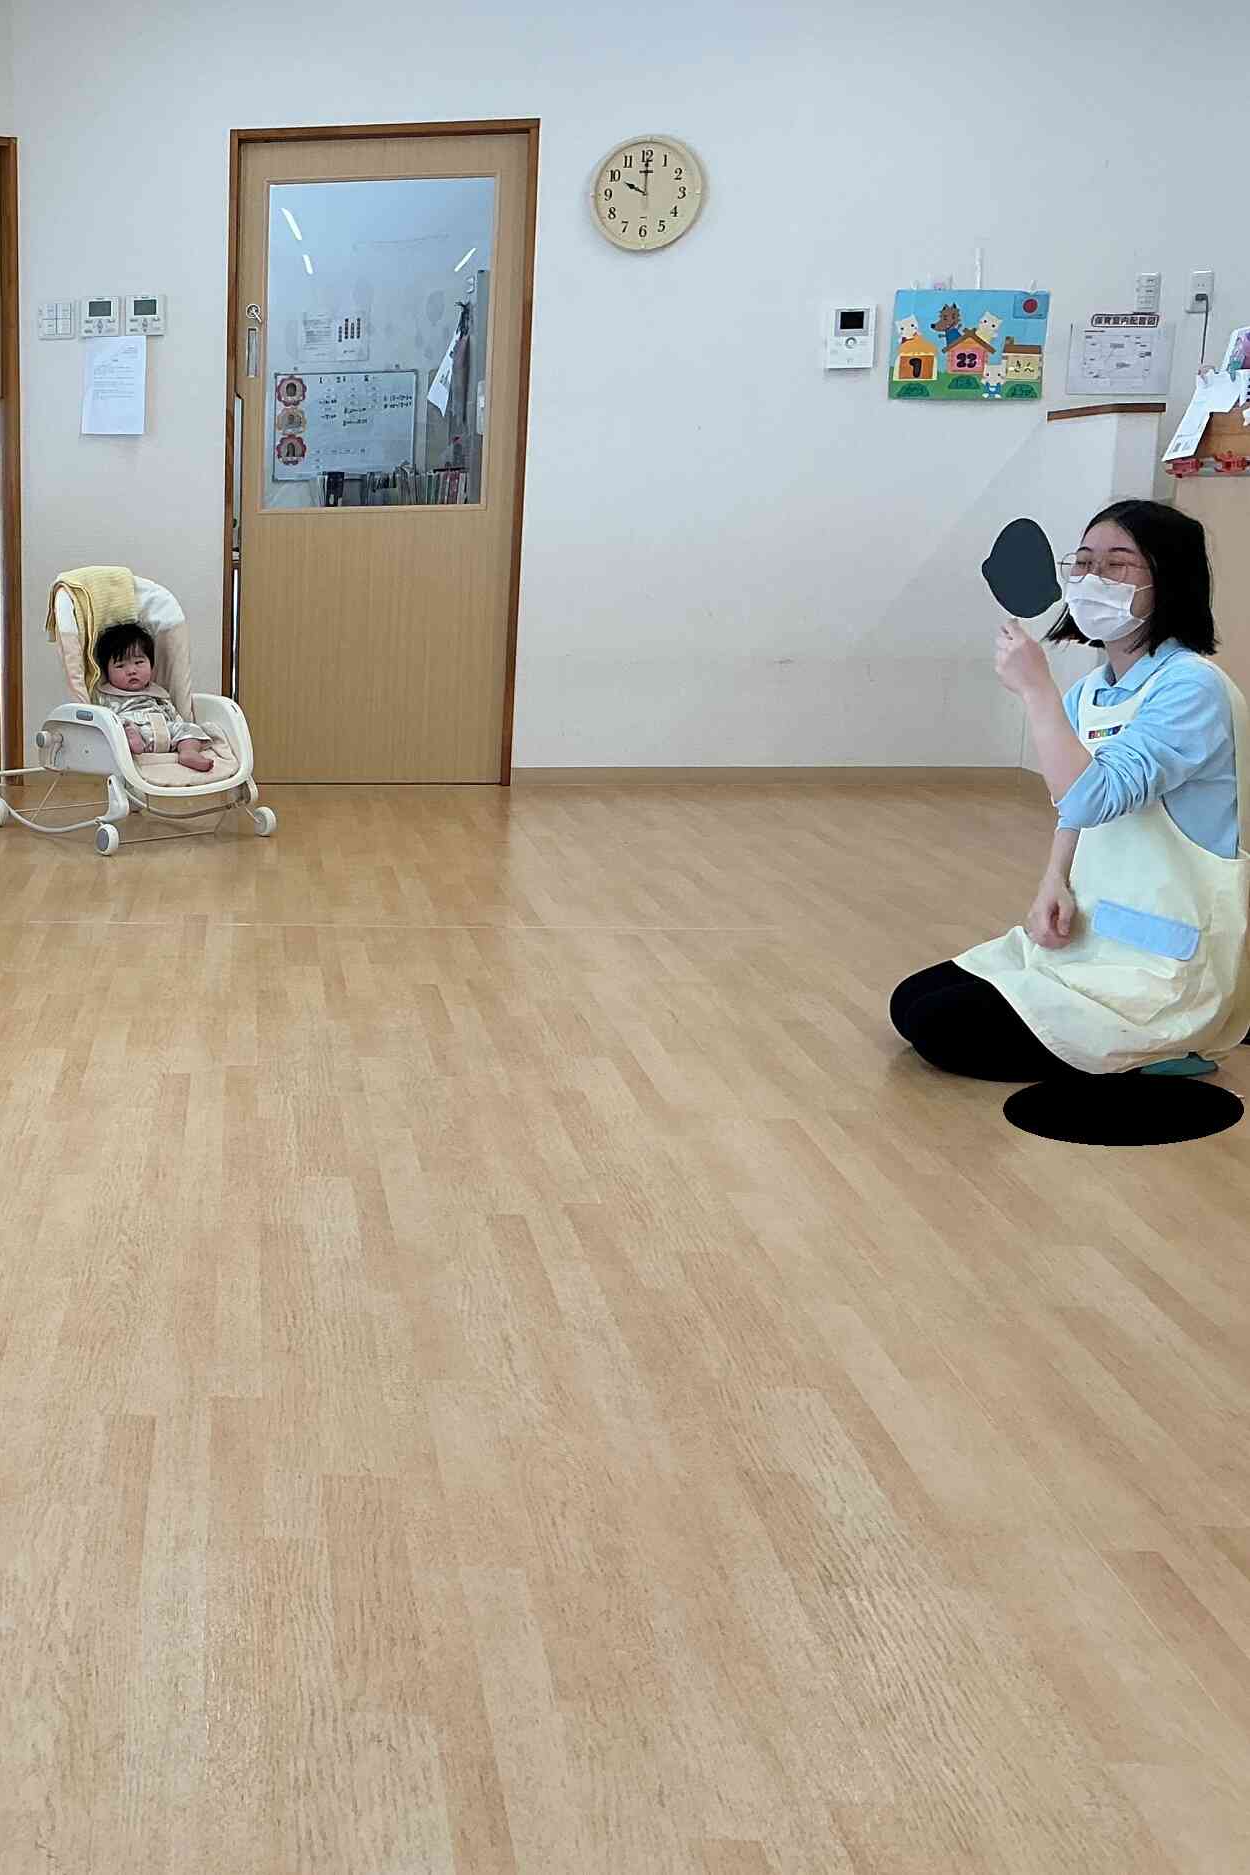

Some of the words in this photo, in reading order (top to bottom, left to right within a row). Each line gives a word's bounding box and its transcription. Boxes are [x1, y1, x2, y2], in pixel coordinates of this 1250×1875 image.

[623, 155, 632, 168] 11
[641, 149, 654, 162] 12
[662, 154, 667, 167] 1
[609, 169, 621, 182] 10
[673, 168, 683, 180] 2
[604, 188, 613, 201] 9
[677, 186, 687, 199] 3
[607, 207, 616, 220] 8
[670, 205, 678, 217] 4
[621, 221, 629, 233] 7
[638, 225, 647, 237] 6
[657, 220, 666, 232] 5
